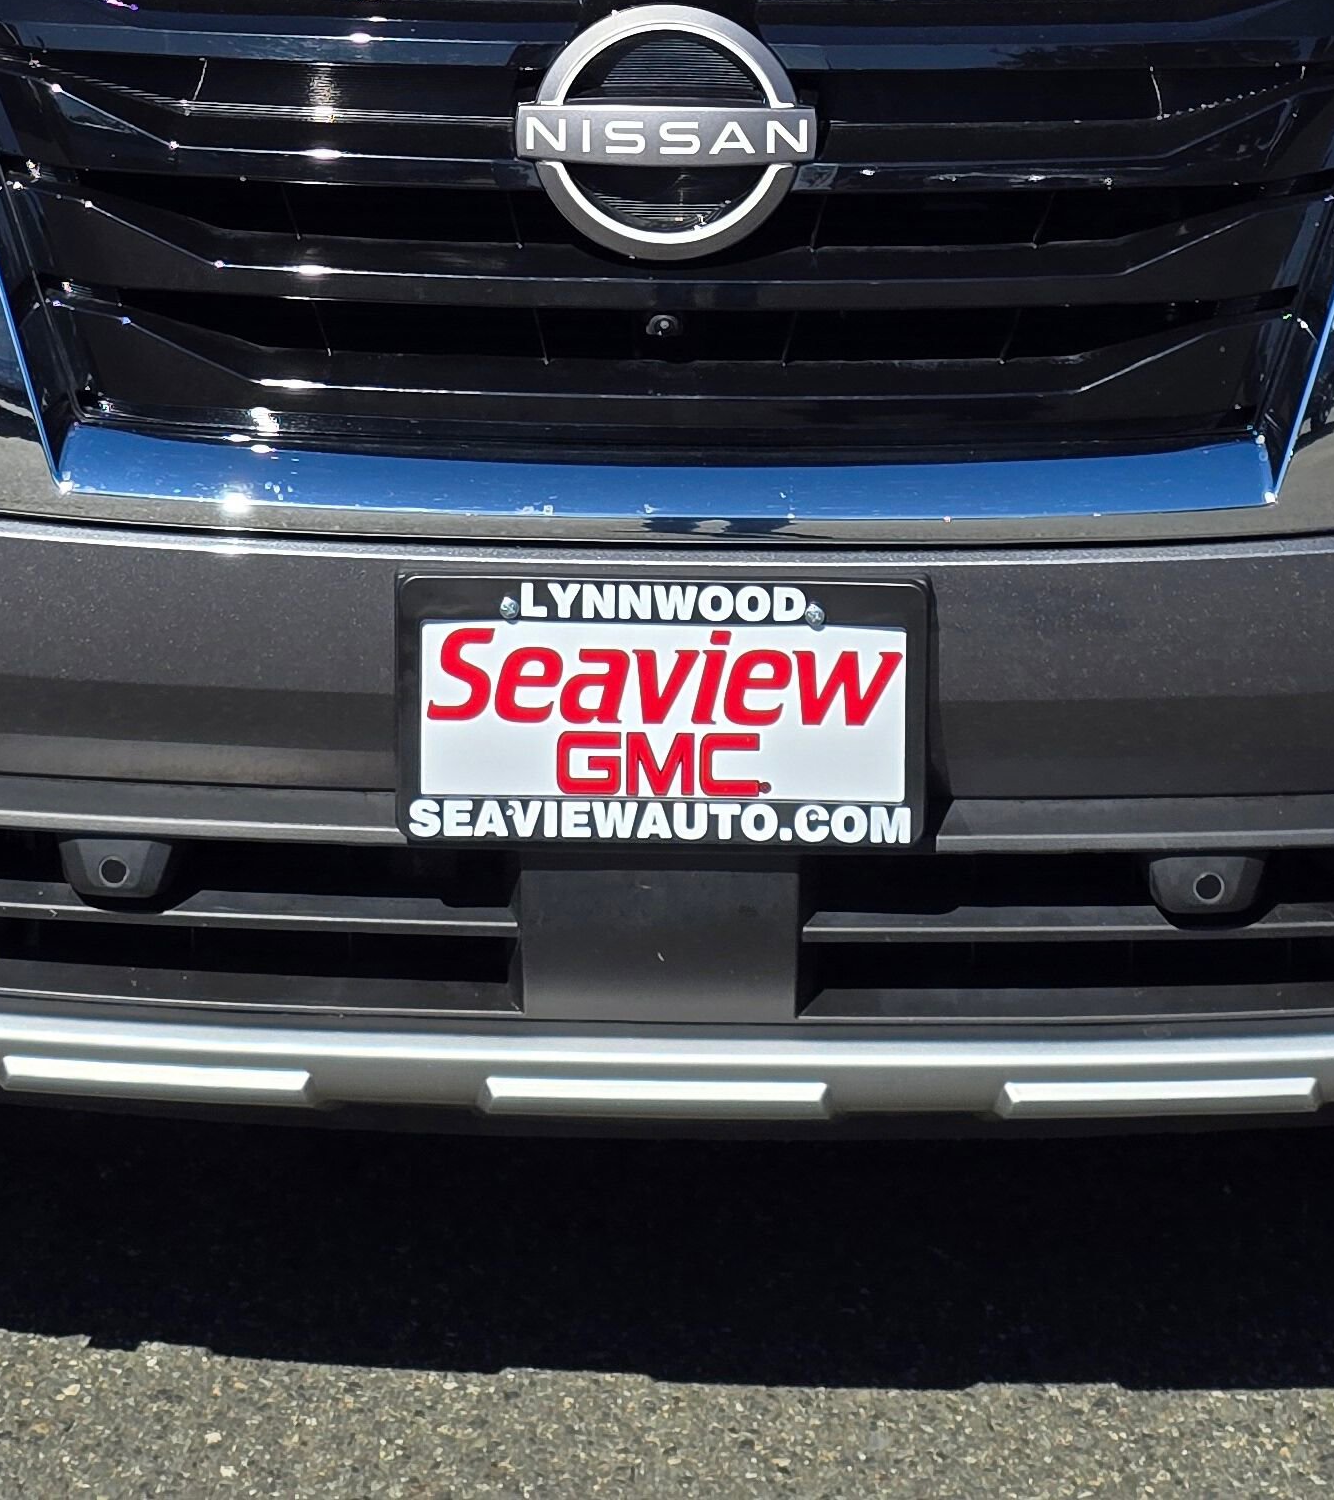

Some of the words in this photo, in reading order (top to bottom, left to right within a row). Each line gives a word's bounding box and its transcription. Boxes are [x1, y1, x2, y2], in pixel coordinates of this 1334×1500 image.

[526, 116, 808, 155] NISSAN
[520, 582, 808, 622] LYNNWOOD
[426, 627, 903, 727] Seaview
[556, 730, 761, 797] GMC
[408, 799, 912, 844] SEAVIEWAUTO.COM
